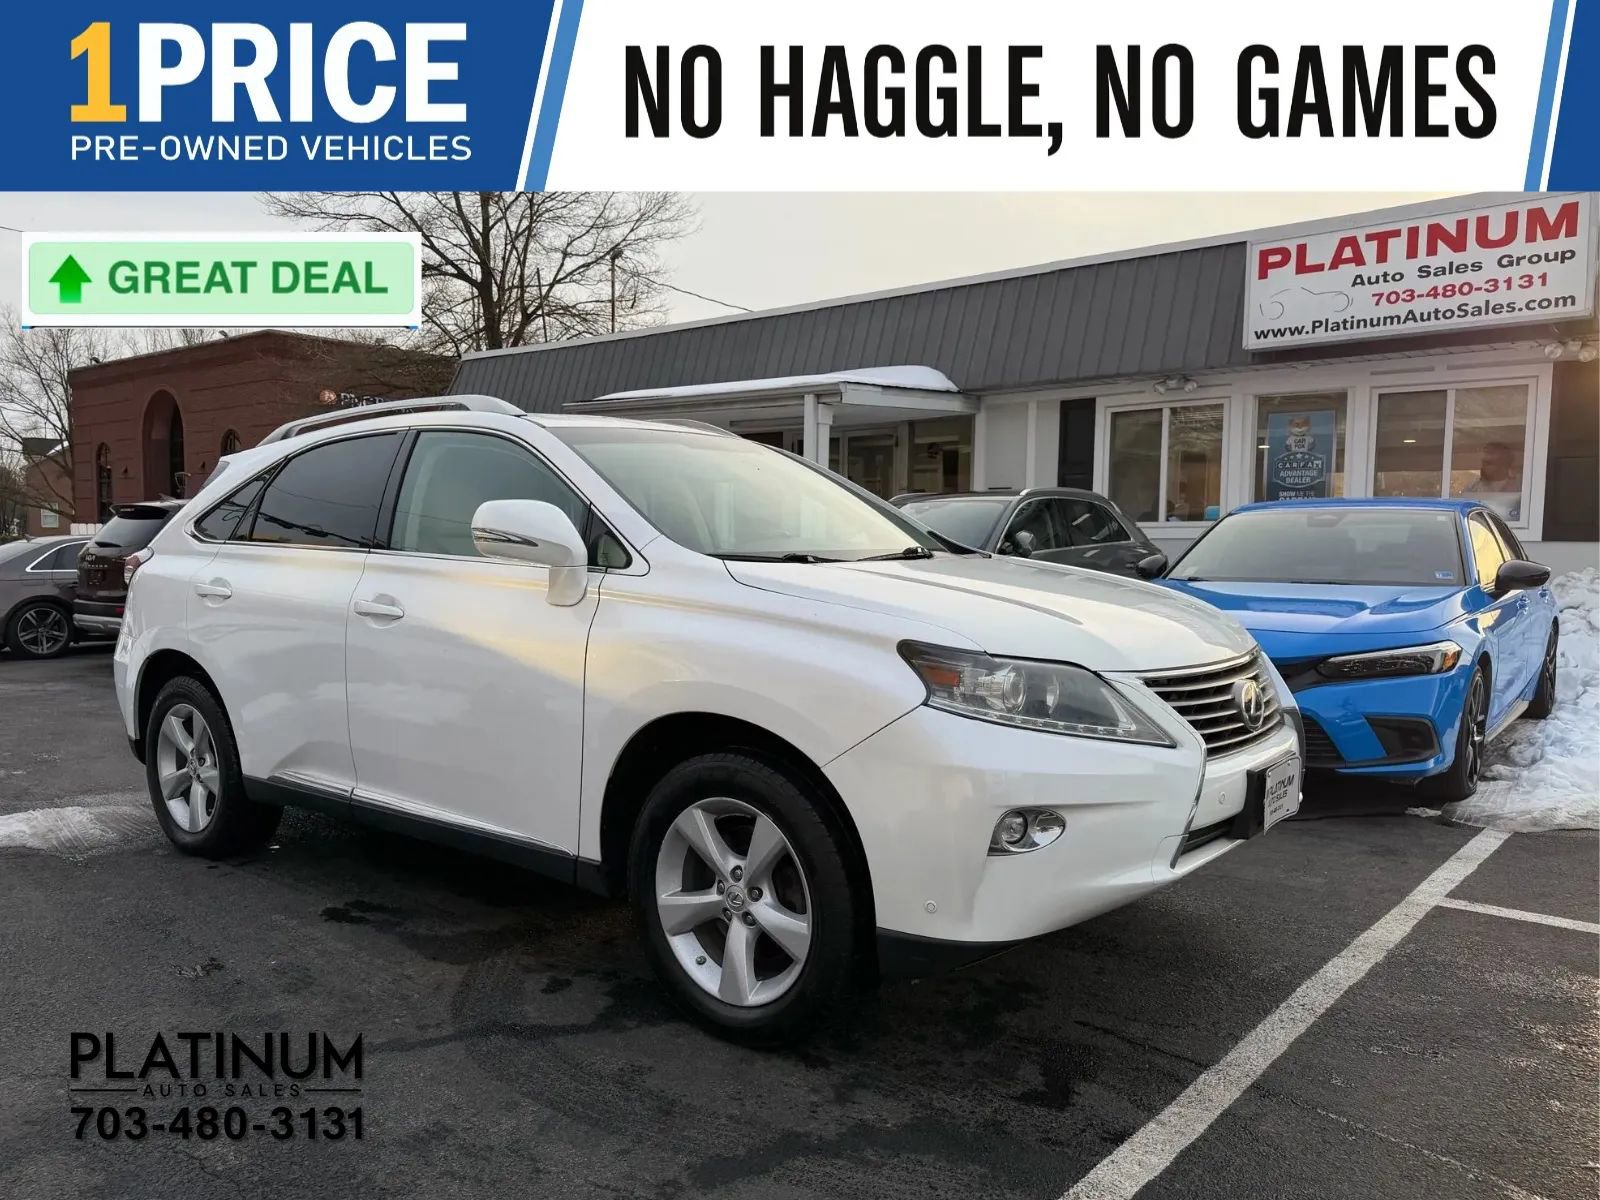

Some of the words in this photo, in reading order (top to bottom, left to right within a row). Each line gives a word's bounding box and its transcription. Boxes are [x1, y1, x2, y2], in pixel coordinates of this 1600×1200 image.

[1257, 201, 1580, 281] PLATINUM
[1351, 270, 1405, 288] Auto
[1417, 258, 1484, 279] Sales
[1497, 248, 1577, 270] Group
[1371, 271, 1549, 307] 703-480-3131
[1254, 293, 1577, 340] www.PlatinumAutoSales.com
[1278, 460, 1322, 469] CARFAX
[1279, 469, 1318, 478] ADVANTAGE
